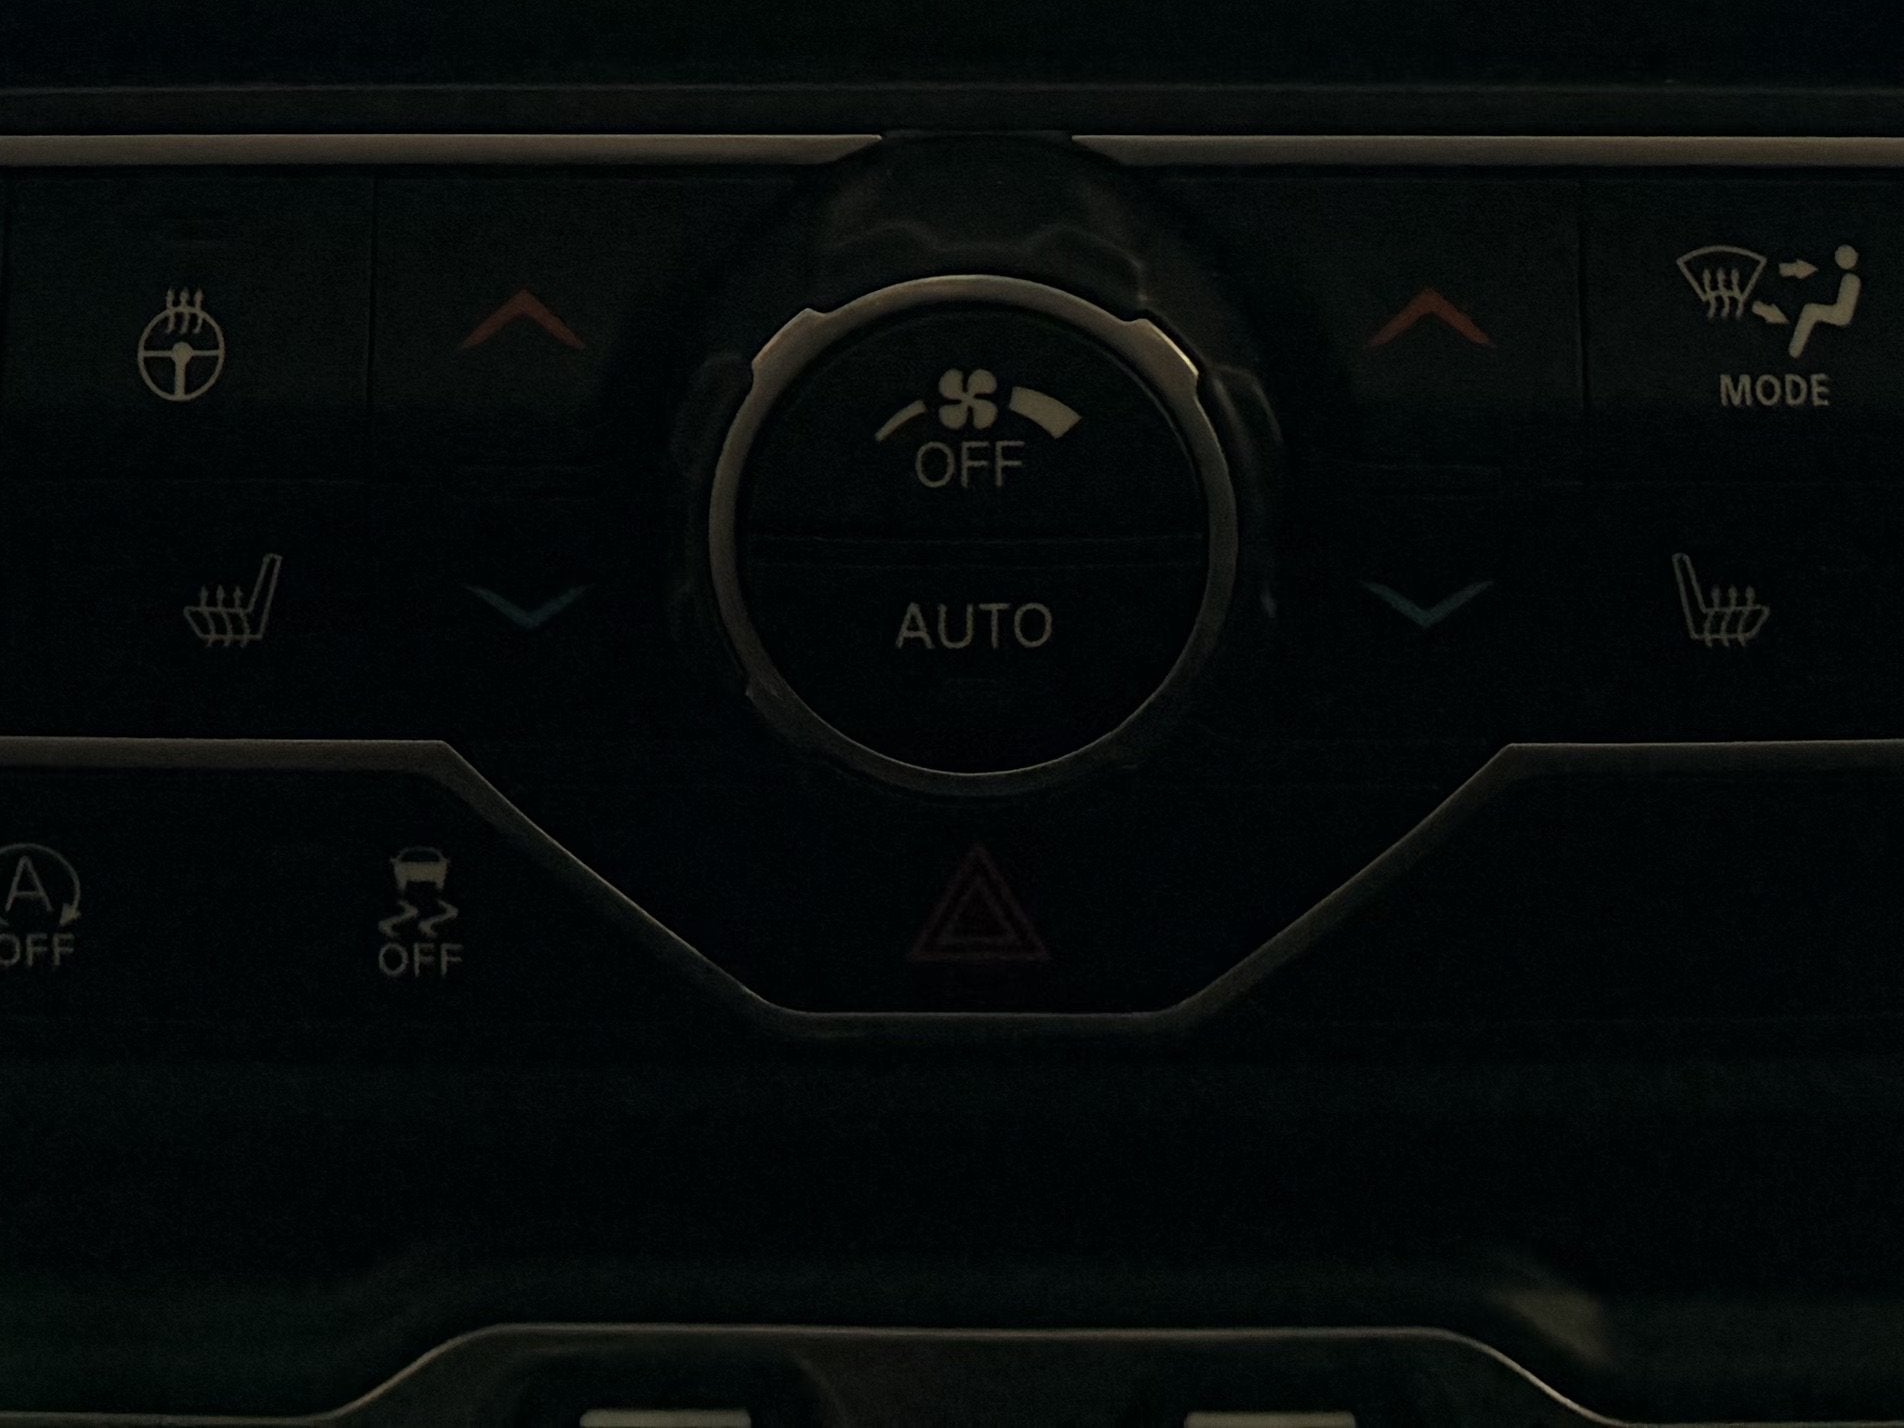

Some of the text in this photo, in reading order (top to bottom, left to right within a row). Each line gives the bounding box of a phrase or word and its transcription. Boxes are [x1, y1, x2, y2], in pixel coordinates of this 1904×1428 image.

[1718, 373, 1832, 409] MODE
[914, 440, 1026, 489] OFF
[896, 602, 1054, 650] AUTO
[377, 940, 465, 978] OFF
